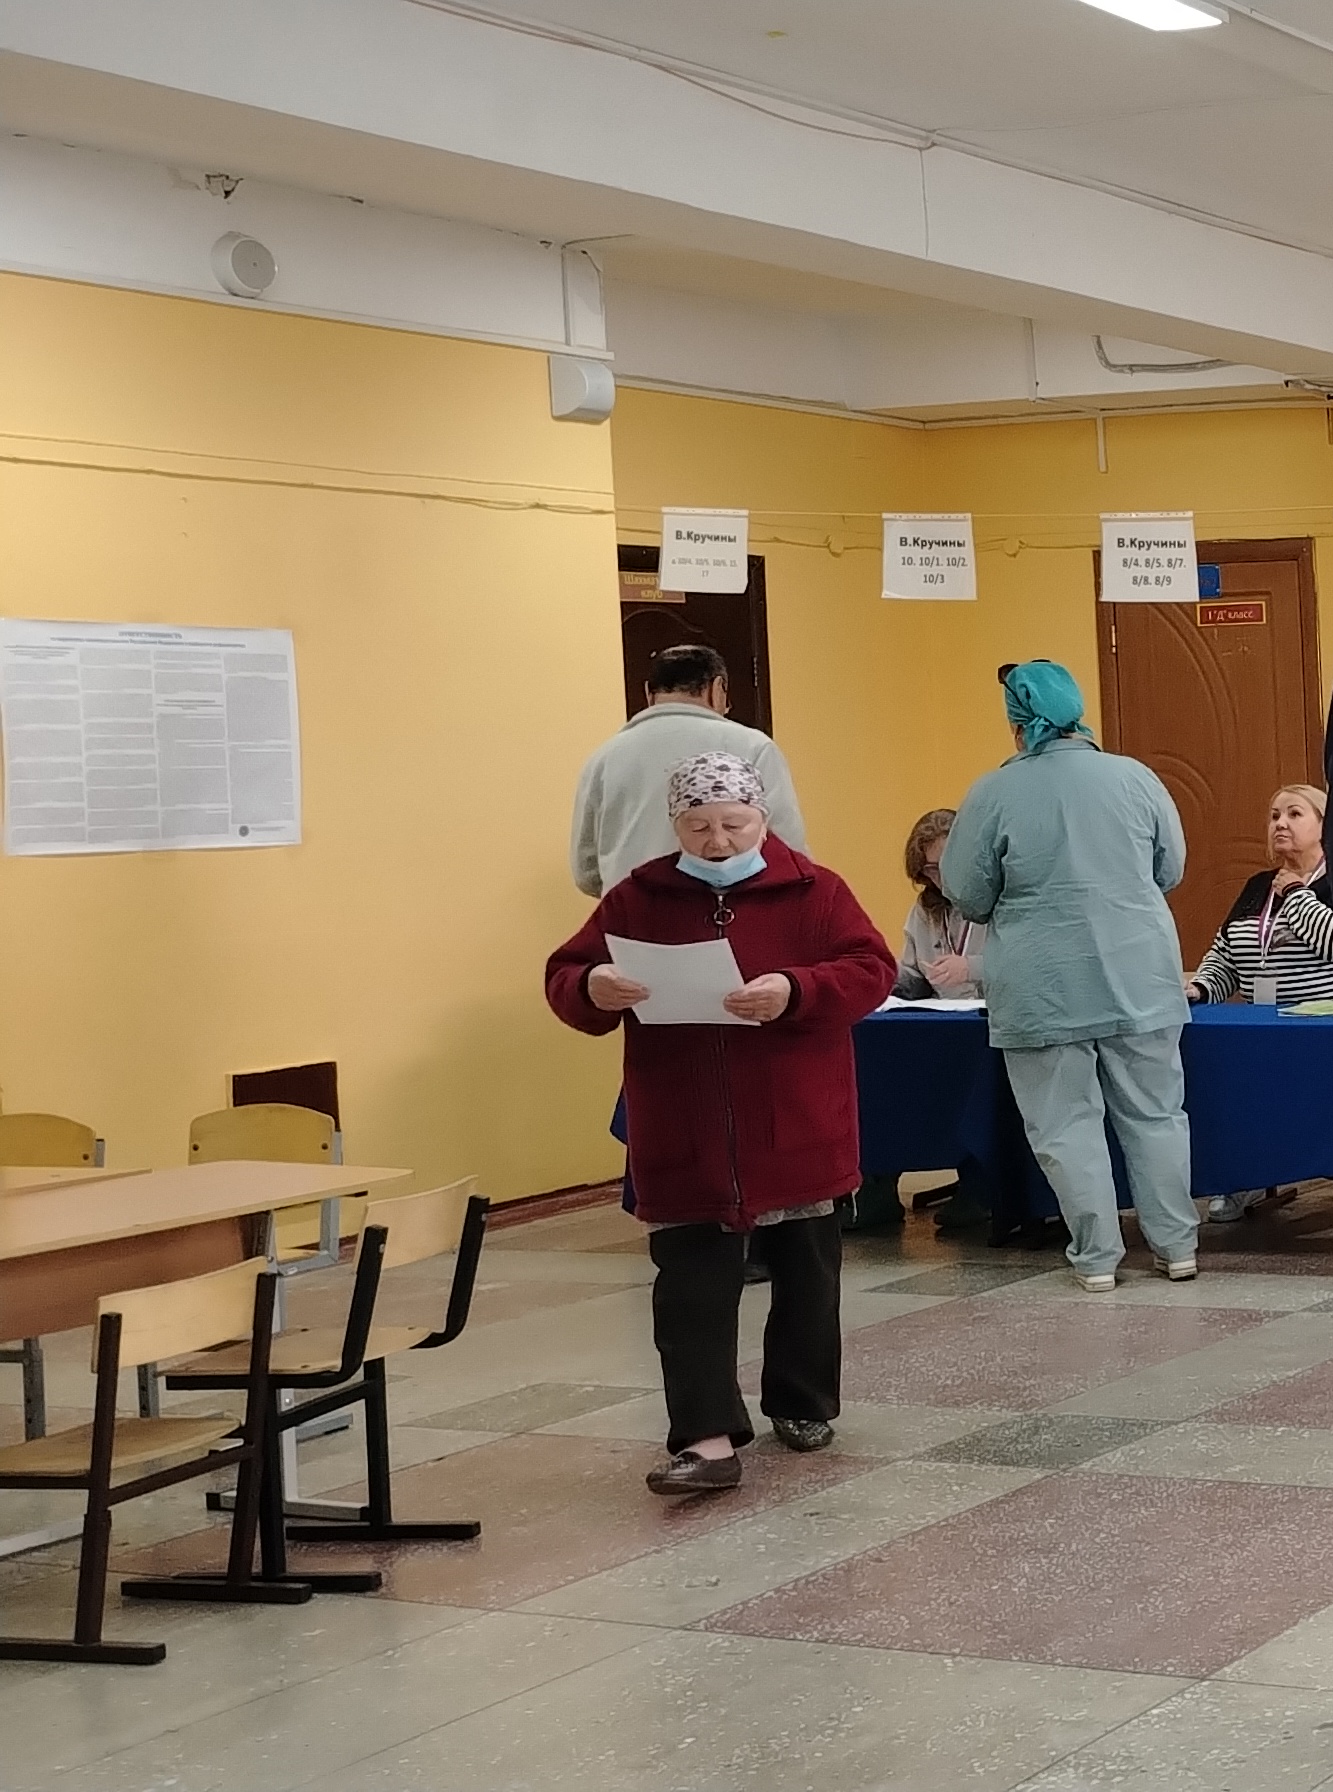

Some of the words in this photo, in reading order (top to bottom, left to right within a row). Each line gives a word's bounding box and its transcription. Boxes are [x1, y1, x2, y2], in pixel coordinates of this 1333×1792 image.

[675, 530, 737, 544] В.Кручины
[899, 536, 966, 550] В.Кручины
[1117, 538, 1187, 551] В.Кручины
[923, 573, 945, 585] 10/3
[1154, 575, 1172, 587] 8/9
